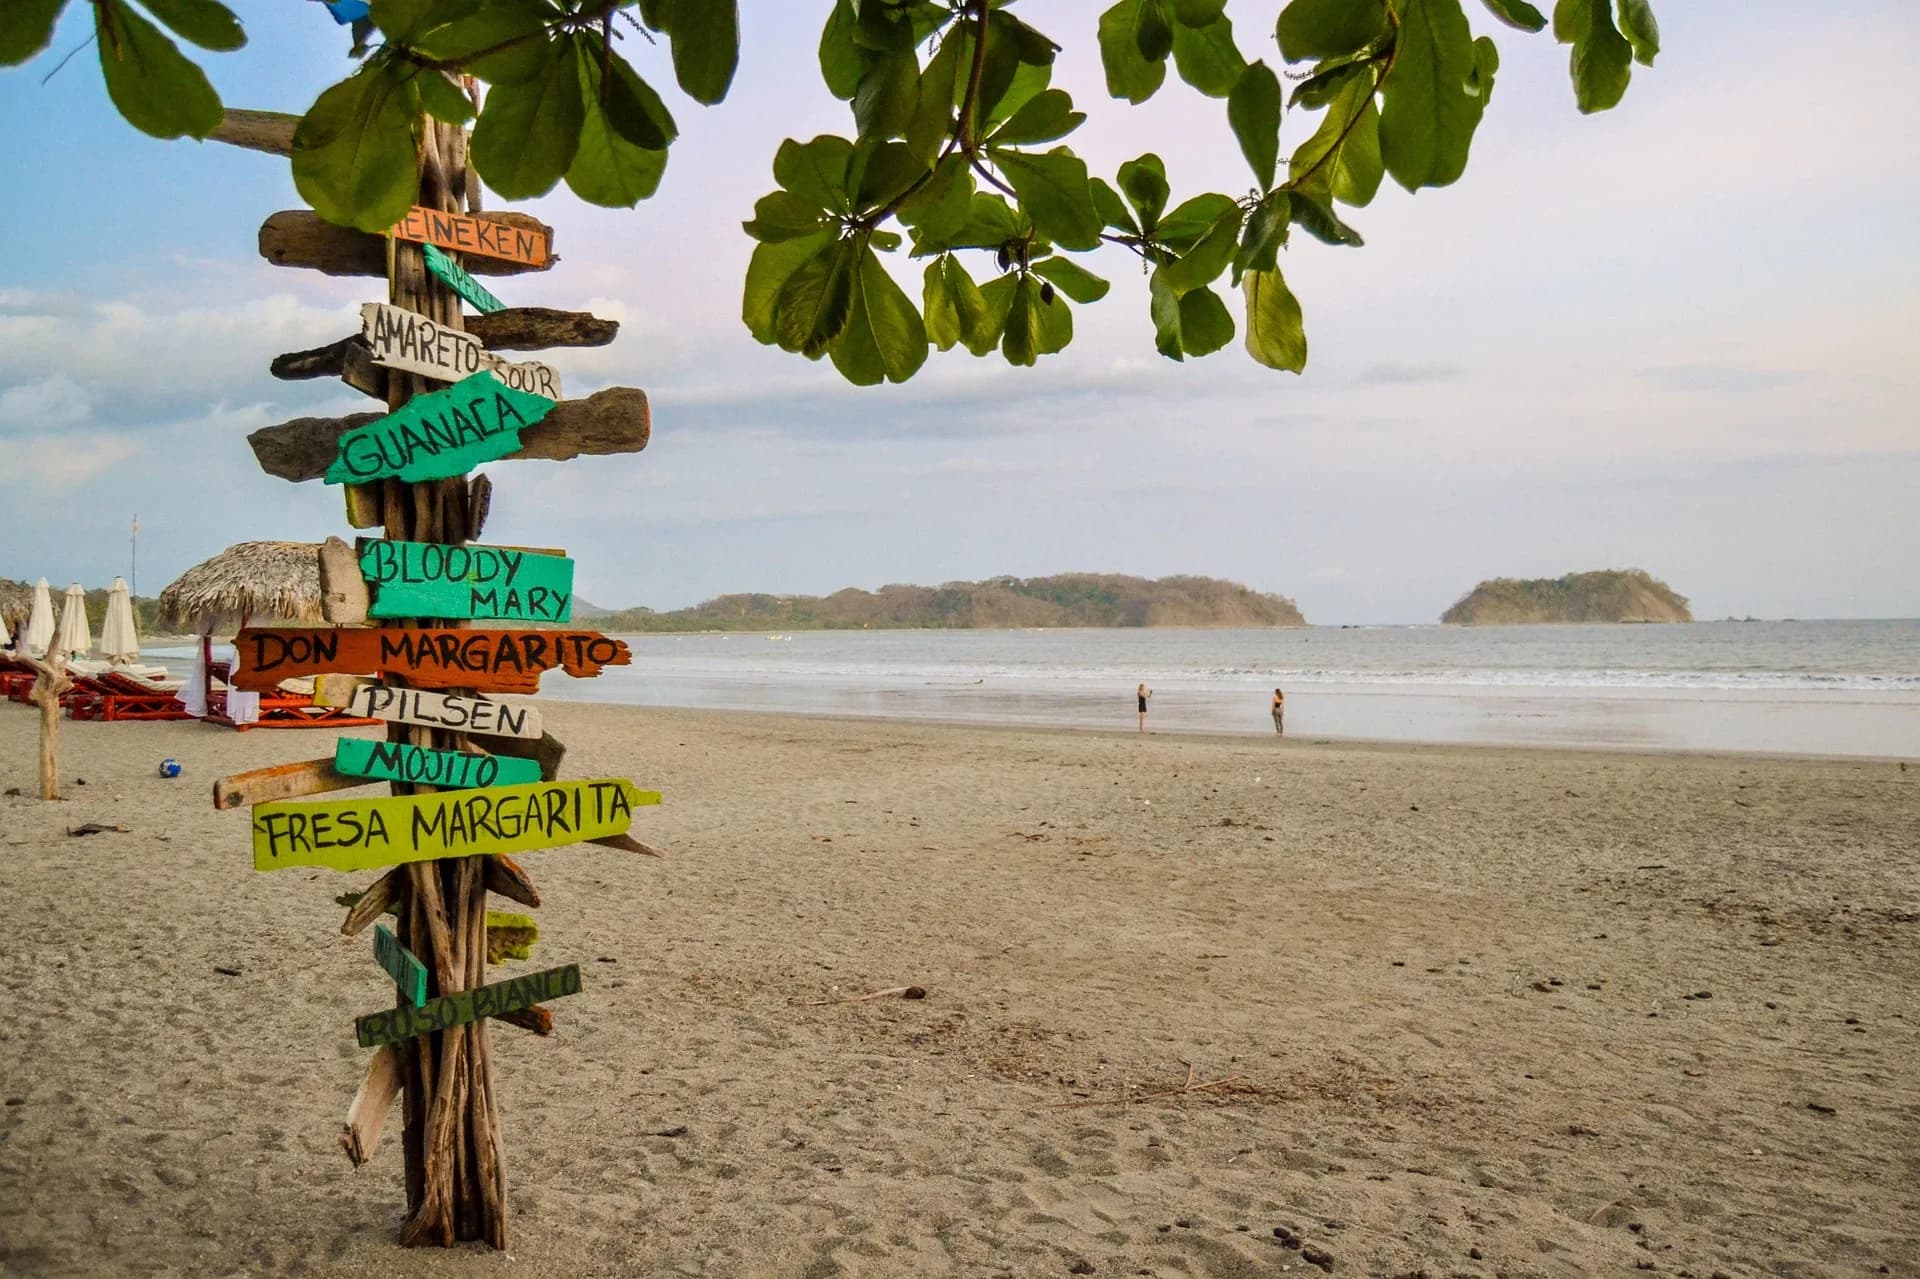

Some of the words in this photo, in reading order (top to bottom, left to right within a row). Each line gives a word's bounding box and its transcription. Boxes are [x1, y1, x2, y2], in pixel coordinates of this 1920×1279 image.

[398, 207, 535, 262] EINEKEN
[373, 303, 480, 371] AMARETO
[342, 392, 525, 476] GUANACA
[368, 540, 522, 584] BLOODY
[470, 586, 568, 618] MARY
[252, 632, 338, 672] DON
[381, 634, 618, 674] MARGARITO
[363, 686, 526, 734] PILSEN
[363, 741, 498, 787] MOJITO
[259, 808, 389, 857] FRESA
[411, 782, 631, 851] MARGARITA
